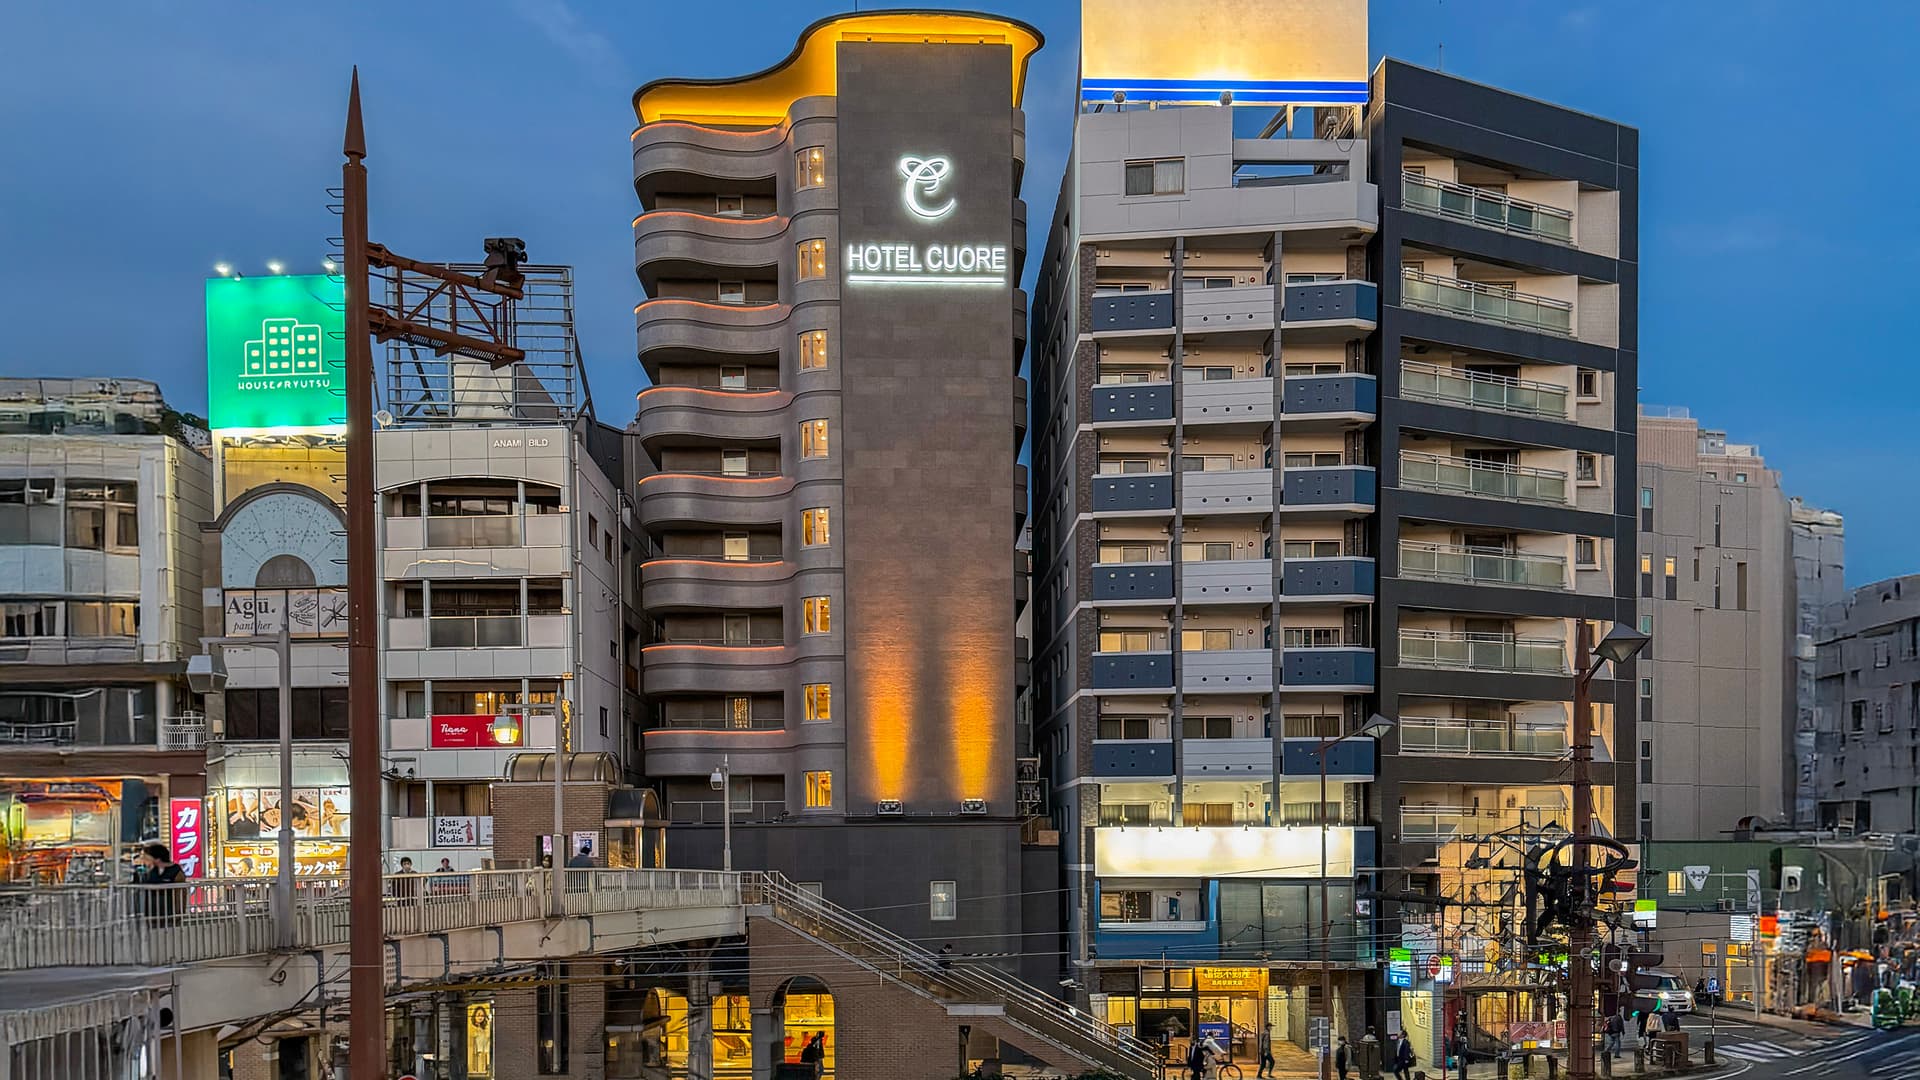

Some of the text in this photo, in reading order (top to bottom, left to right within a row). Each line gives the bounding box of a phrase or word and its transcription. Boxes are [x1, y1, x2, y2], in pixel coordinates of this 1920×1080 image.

[849, 244, 1006, 271] HOTEL CUORE
[493, 438, 549, 448] ANAMI BILD
[440, 818, 459, 827] Sissi
[437, 834, 464, 844] Studio
